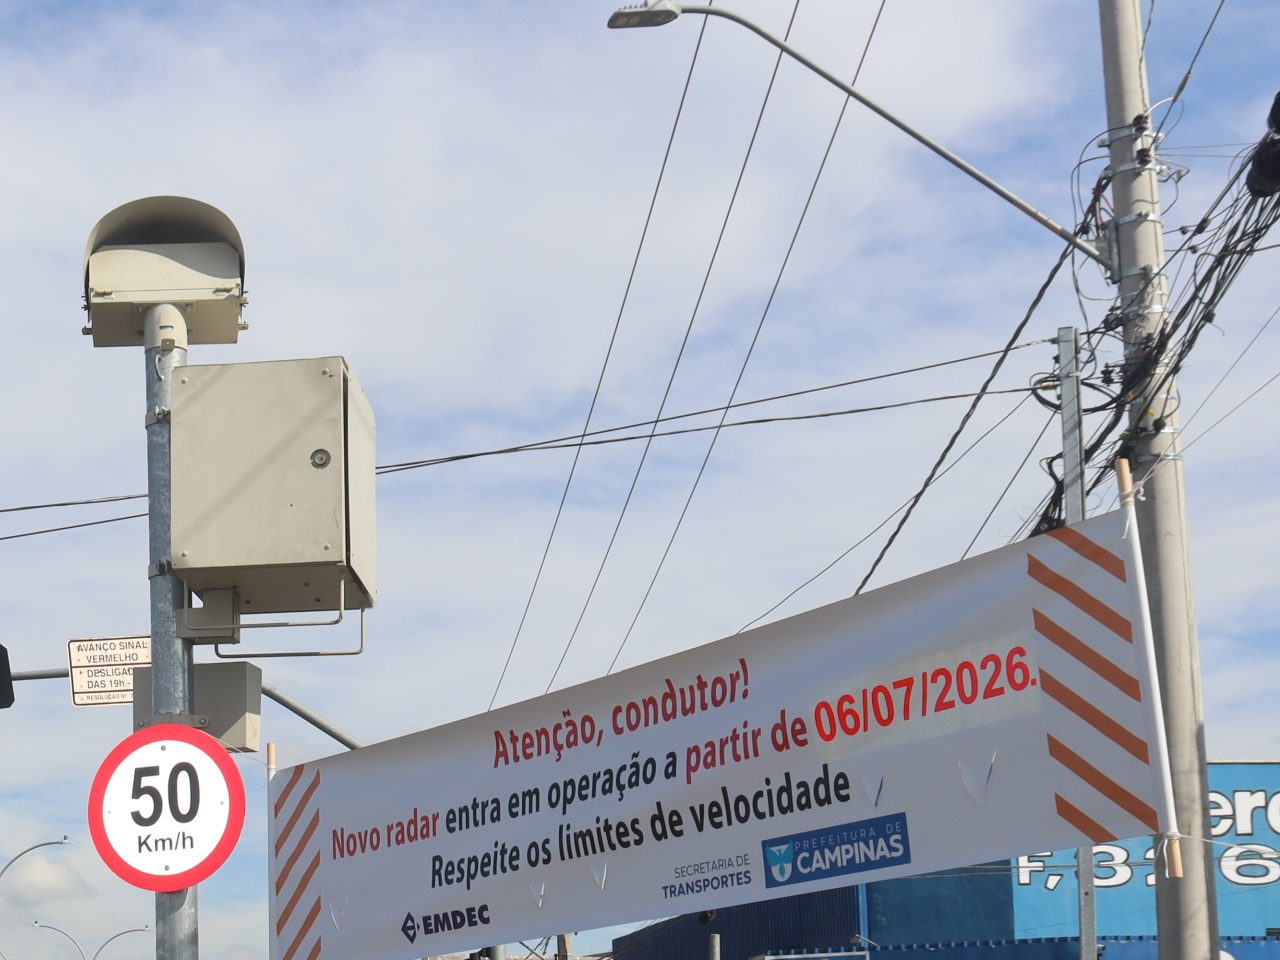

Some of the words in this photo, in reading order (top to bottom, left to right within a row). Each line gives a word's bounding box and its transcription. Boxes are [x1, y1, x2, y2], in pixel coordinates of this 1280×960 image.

[77, 642, 117, 653] AVANÇO
[118, 640, 148, 651] SINAL
[86, 653, 139, 663] VERMELHO
[87, 667, 134, 678] DESLIGAD
[87, 680, 107, 689] DAS
[109, 679, 125, 688] 19h
[493, 709, 605, 768] Atenção,
[612, 658, 749, 736] condutor!
[332, 827, 381, 860] Novo
[386, 808, 440, 848] radar
[445, 797, 501, 833] entra
[508, 787, 540, 818] em
[547, 750, 657, 815] operação
[664, 751, 677, 780] a
[685, 720, 762, 784] partir
[770, 710, 809, 753] de
[814, 646, 1038, 742] 06/07/2026.
[130, 761, 200, 827] 50
[431, 841, 520, 890] Respeite
[526, 838, 552, 868] os
[558, 815, 645, 861] limites
[650, 801, 684, 842] de
[689, 763, 851, 832] velocidade
[794, 827, 876, 851] PREFEITURA
[886, 822, 902, 834] DE
[138, 831, 194, 853] Km/h
[796, 834, 904, 874] CAMPINAS
[674, 857, 734, 879] SECRETARIA
[736, 854, 750, 867] DE
[661, 870, 752, 899] TRANSPORTES
[423, 904, 491, 936] EMDEC
